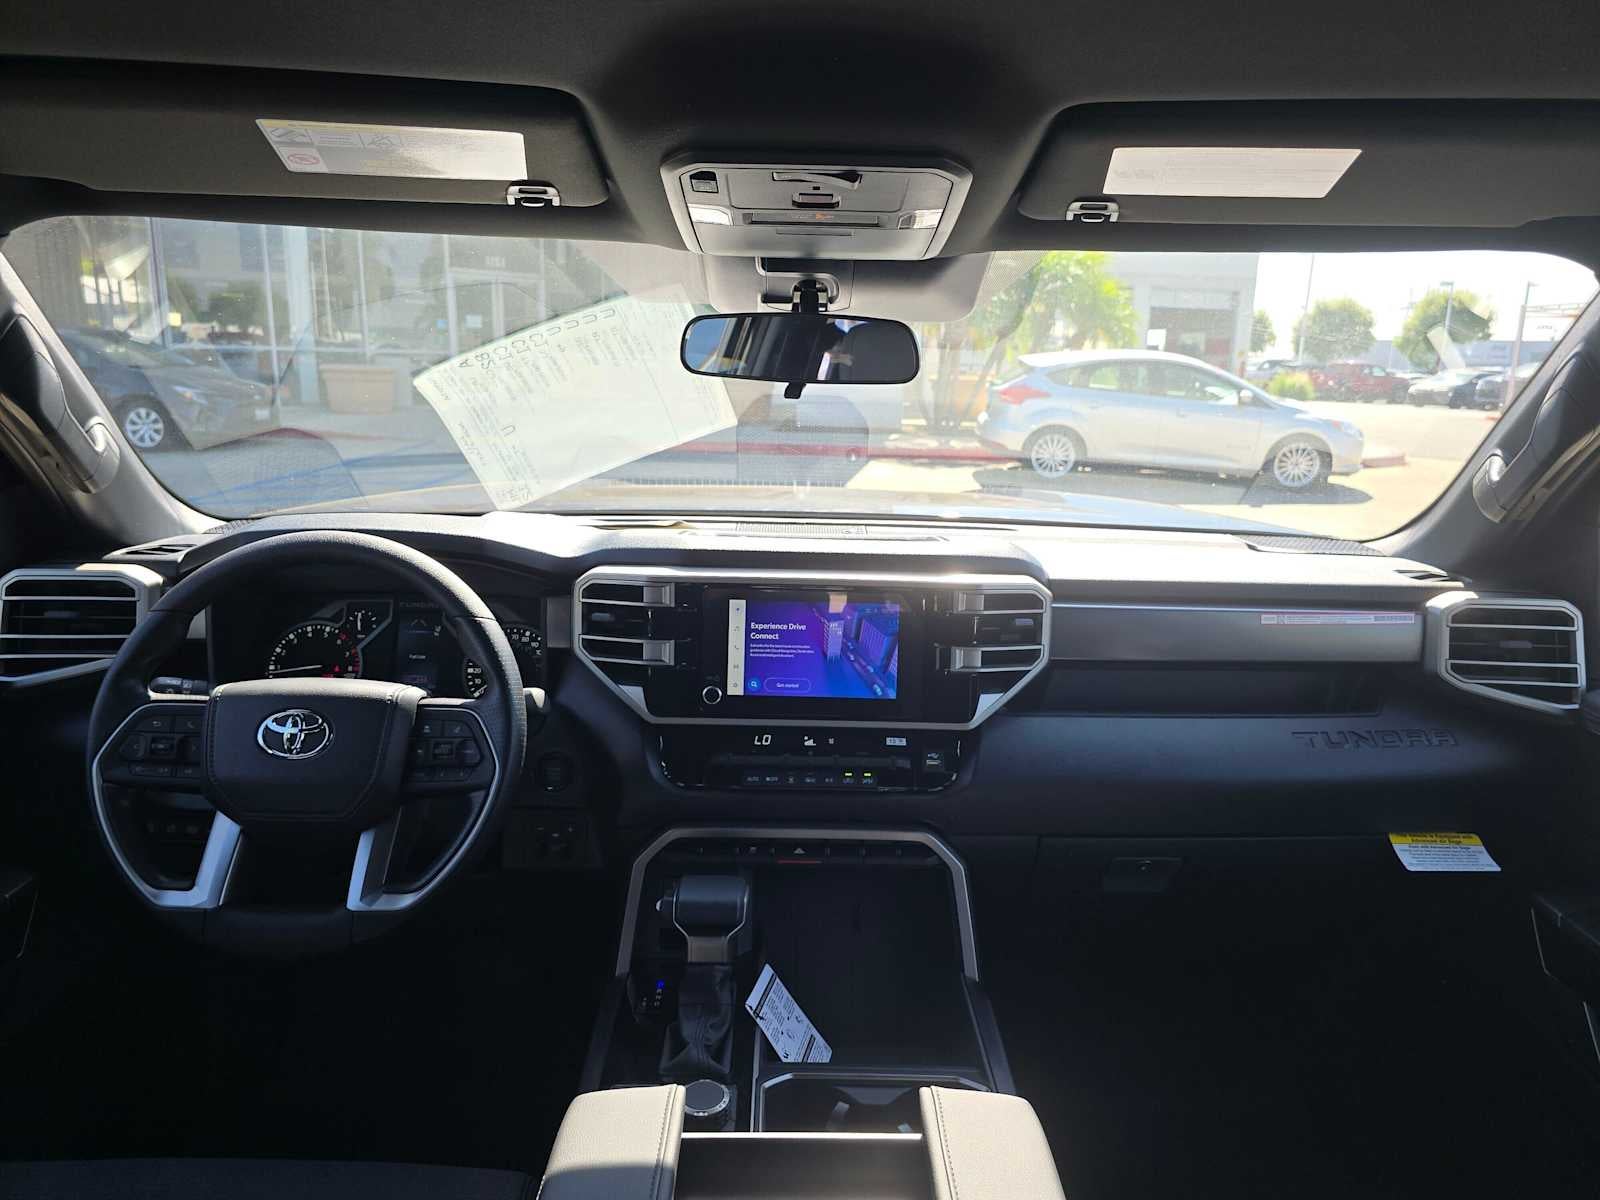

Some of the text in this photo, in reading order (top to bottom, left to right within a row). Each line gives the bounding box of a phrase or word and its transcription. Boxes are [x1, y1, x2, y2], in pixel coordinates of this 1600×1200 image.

[751, 622, 806, 631] Experience Drive
[750, 632, 779, 640] Connect
[754, 734, 772, 746] LO
[1291, 729, 1460, 749] TUNDRA
